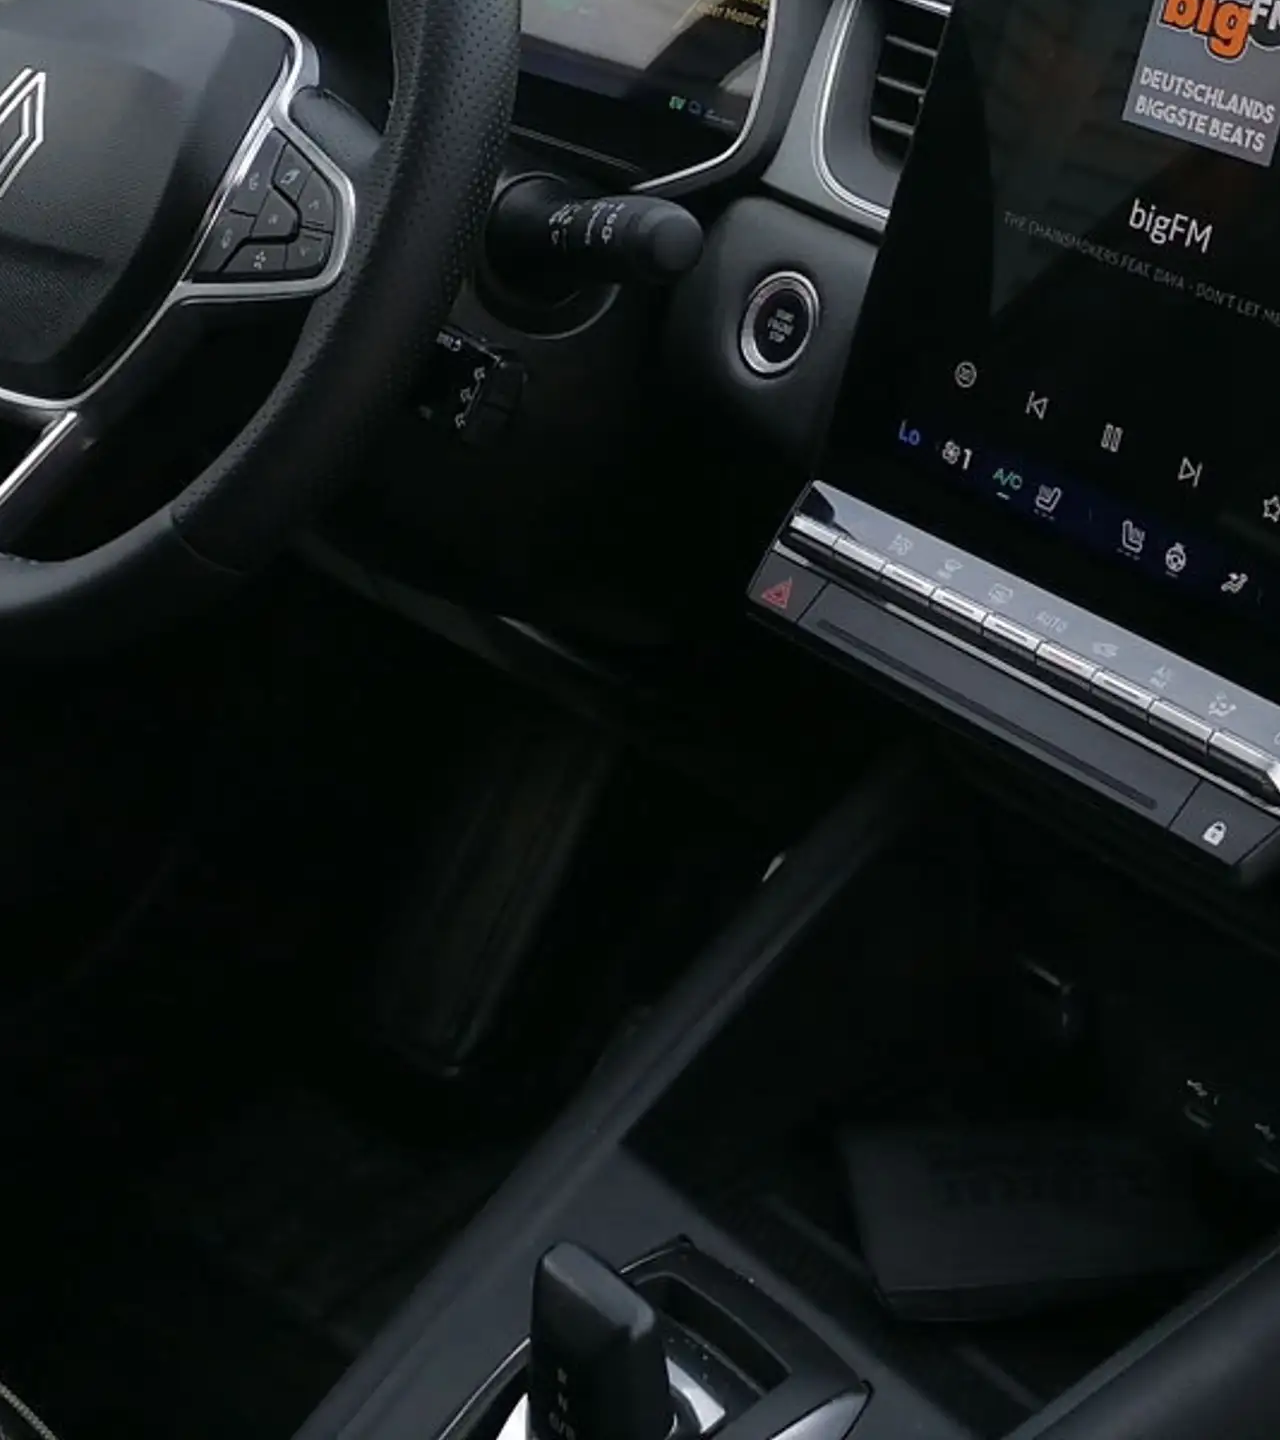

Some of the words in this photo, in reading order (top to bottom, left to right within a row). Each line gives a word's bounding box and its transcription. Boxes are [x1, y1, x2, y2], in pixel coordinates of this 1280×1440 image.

[1134, 94, 1207, 134] BIGGSTE
[1208, 114, 1266, 153] BEATS
[1139, 66, 1275, 125] DEUTSCHLANDS
[1128, 197, 1214, 254] bigFM
[1236, 297, 1262, 319] LET
[992, 466, 1023, 492] A/C
